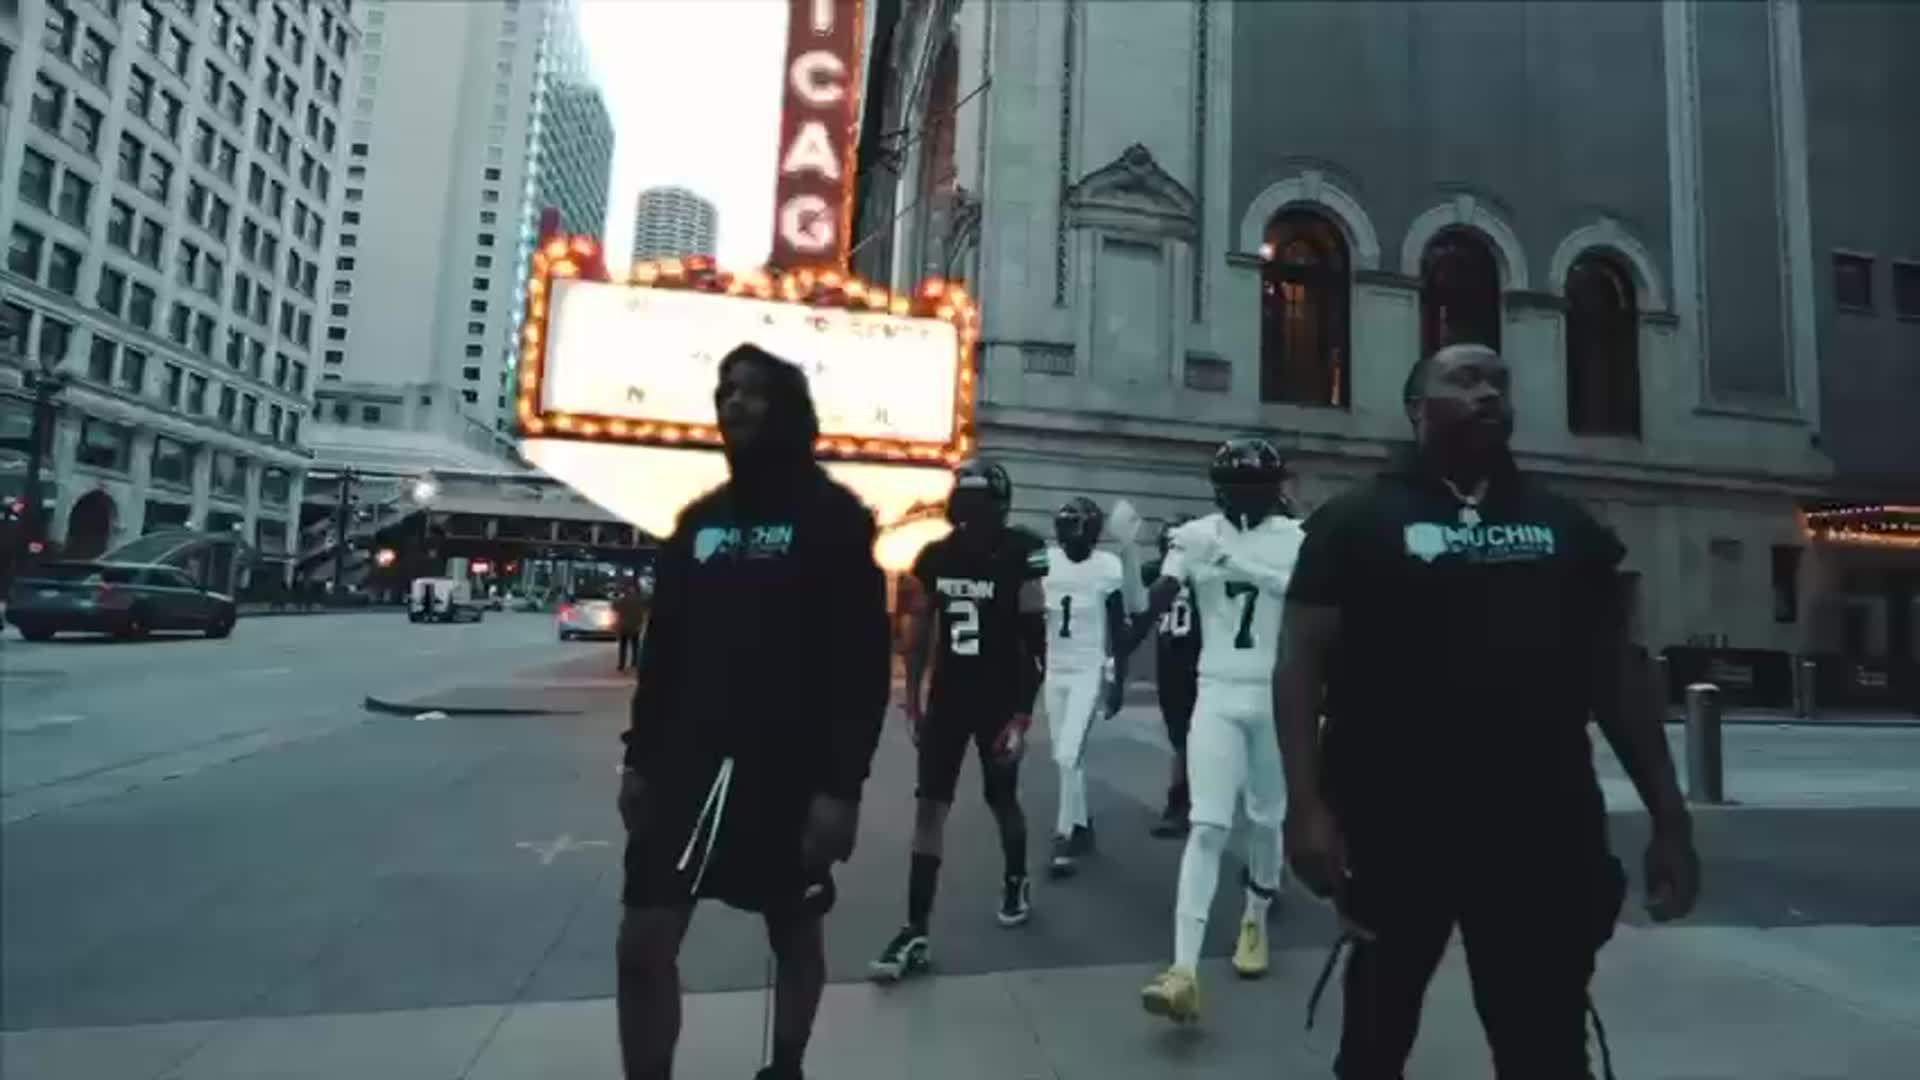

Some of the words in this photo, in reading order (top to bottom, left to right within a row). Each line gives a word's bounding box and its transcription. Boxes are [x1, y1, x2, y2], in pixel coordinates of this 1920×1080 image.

[1444, 525, 1555, 547] MUCHIN
[946, 600, 980, 655] 2
[1058, 595, 1072, 638] 1
[1224, 581, 1259, 649] 7
